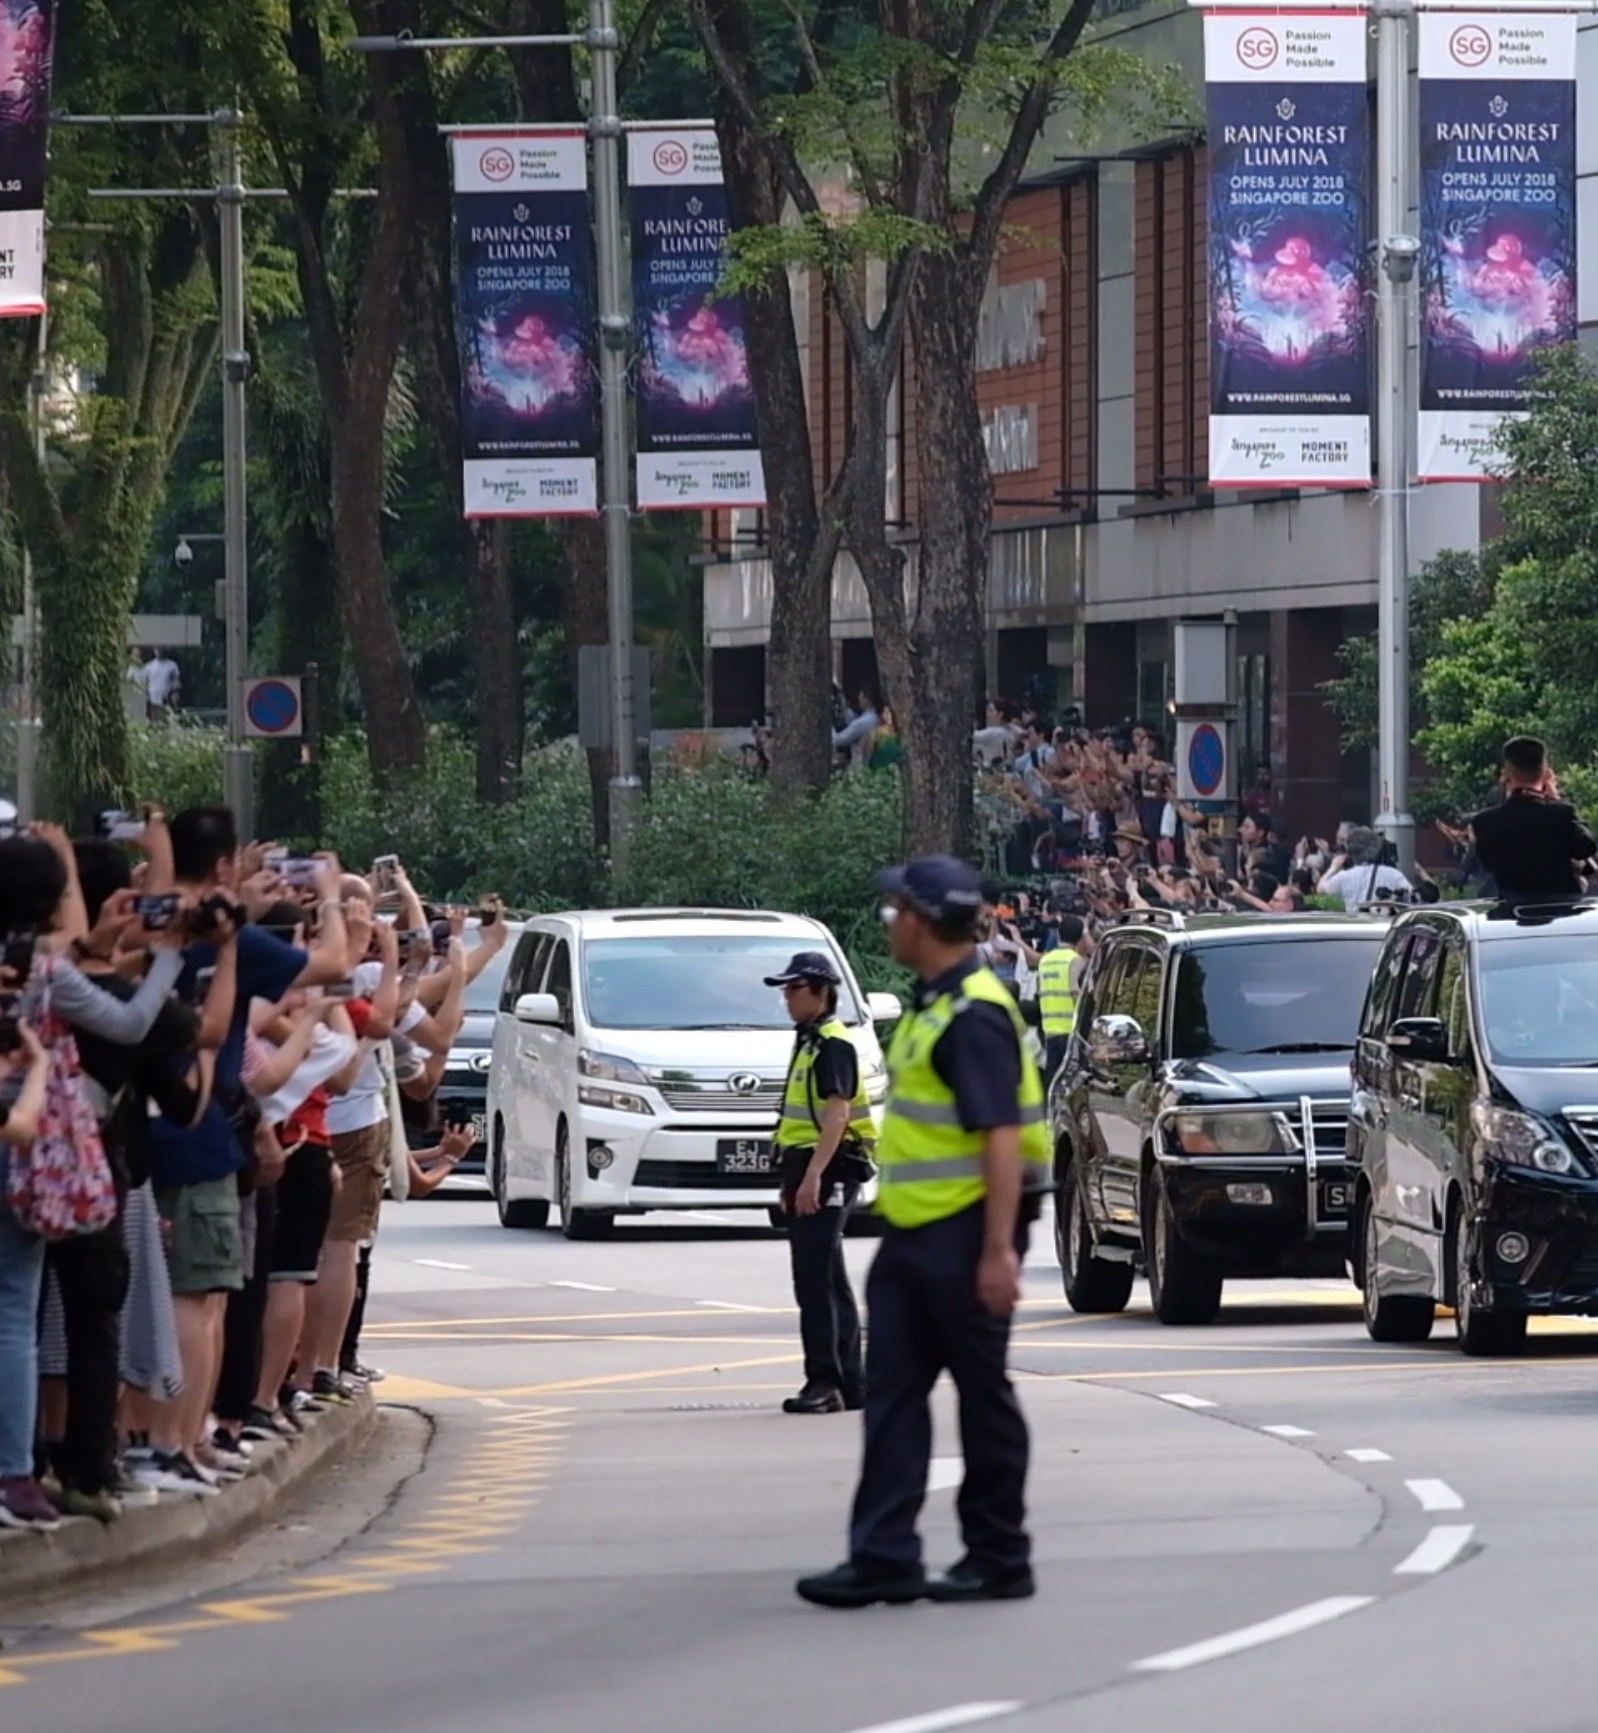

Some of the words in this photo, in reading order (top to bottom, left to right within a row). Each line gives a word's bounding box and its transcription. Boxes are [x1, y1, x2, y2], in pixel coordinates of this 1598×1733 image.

[1285, 30, 1331, 41] Passion
[1499, 28, 1544, 38] Passion
[1243, 40, 1273, 58] SG
[1286, 44, 1318, 54] Made
[1456, 37, 1486, 55] SG
[1499, 41, 1531, 51] Made
[1286, 57, 1335, 68] Possible
[1499, 55, 1547, 65] Possible
[1224, 125, 1347, 144] RAINFOREST
[1436, 122, 1560, 142] RAINFOREST
[658, 150, 683, 166] SG
[1244, 148, 1328, 166] LUMINA
[1456, 144, 1540, 163] LUMINA
[484, 157, 510, 173] SG
[1230, 175, 1275, 189] OPENS
[1278, 175, 1309, 189] JULY
[1312, 175, 1344, 189] 2018
[1441, 172, 1487, 186] OPENS
[1490, 173, 1521, 186] JULY
[1524, 173, 1556, 187] 2018
[1230, 191, 1309, 206] SINGAPORE
[1312, 191, 1345, 205] ZOO
[1442, 189, 1520, 203] SINGAPORE
[1523, 189, 1556, 202] ZOO
[471, 225, 572, 243] RAINFOREST
[644, 219, 727, 236] RAINFORE
[488, 243, 557, 260] LUMINA
[477, 266, 514, 278] OPENS
[516, 266, 542, 278] JULY
[544, 266, 571, 277] 2018
[650, 259, 687, 271] OPENS
[690, 259, 714, 271] JULY
[477, 278, 542, 291] SINGAPORE
[544, 278, 571, 290] ZOO
[651, 271, 714, 284] SINGAPORE
[1226, 393, 1352, 404] WWW.RAINFORESTLUMINA.SG
[1301, 441, 1348, 451] MOMENT
[1301, 452, 1348, 463] FACTORY
[736, 1141, 758, 1155] EJ
[724, 1154, 770, 1169] 323G
